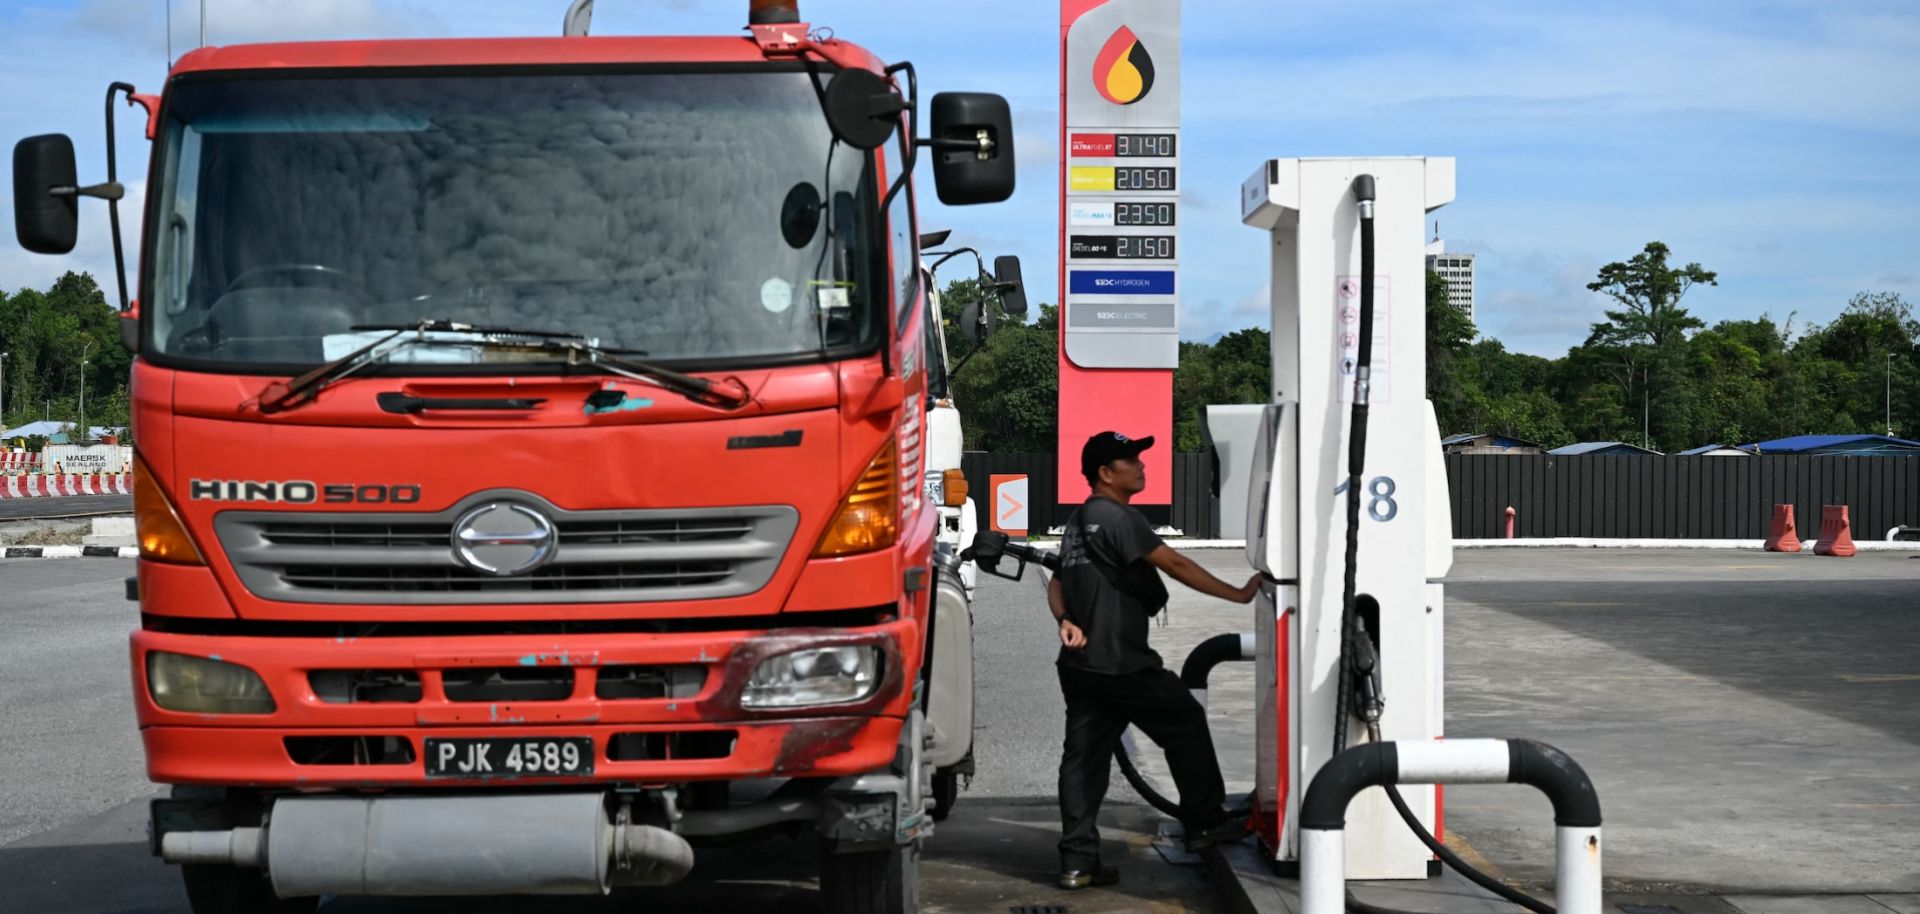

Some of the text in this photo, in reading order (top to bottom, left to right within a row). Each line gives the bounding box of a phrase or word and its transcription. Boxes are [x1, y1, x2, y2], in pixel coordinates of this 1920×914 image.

[1118, 136, 1170, 156] 3.140
[1117, 169, 1169, 188] 2.050
[1117, 204, 1169, 224] 2.350
[1117, 237, 1169, 257] 2.150
[190, 479, 421, 504] HINO 500
[438, 742, 580, 772] PJK 4589
